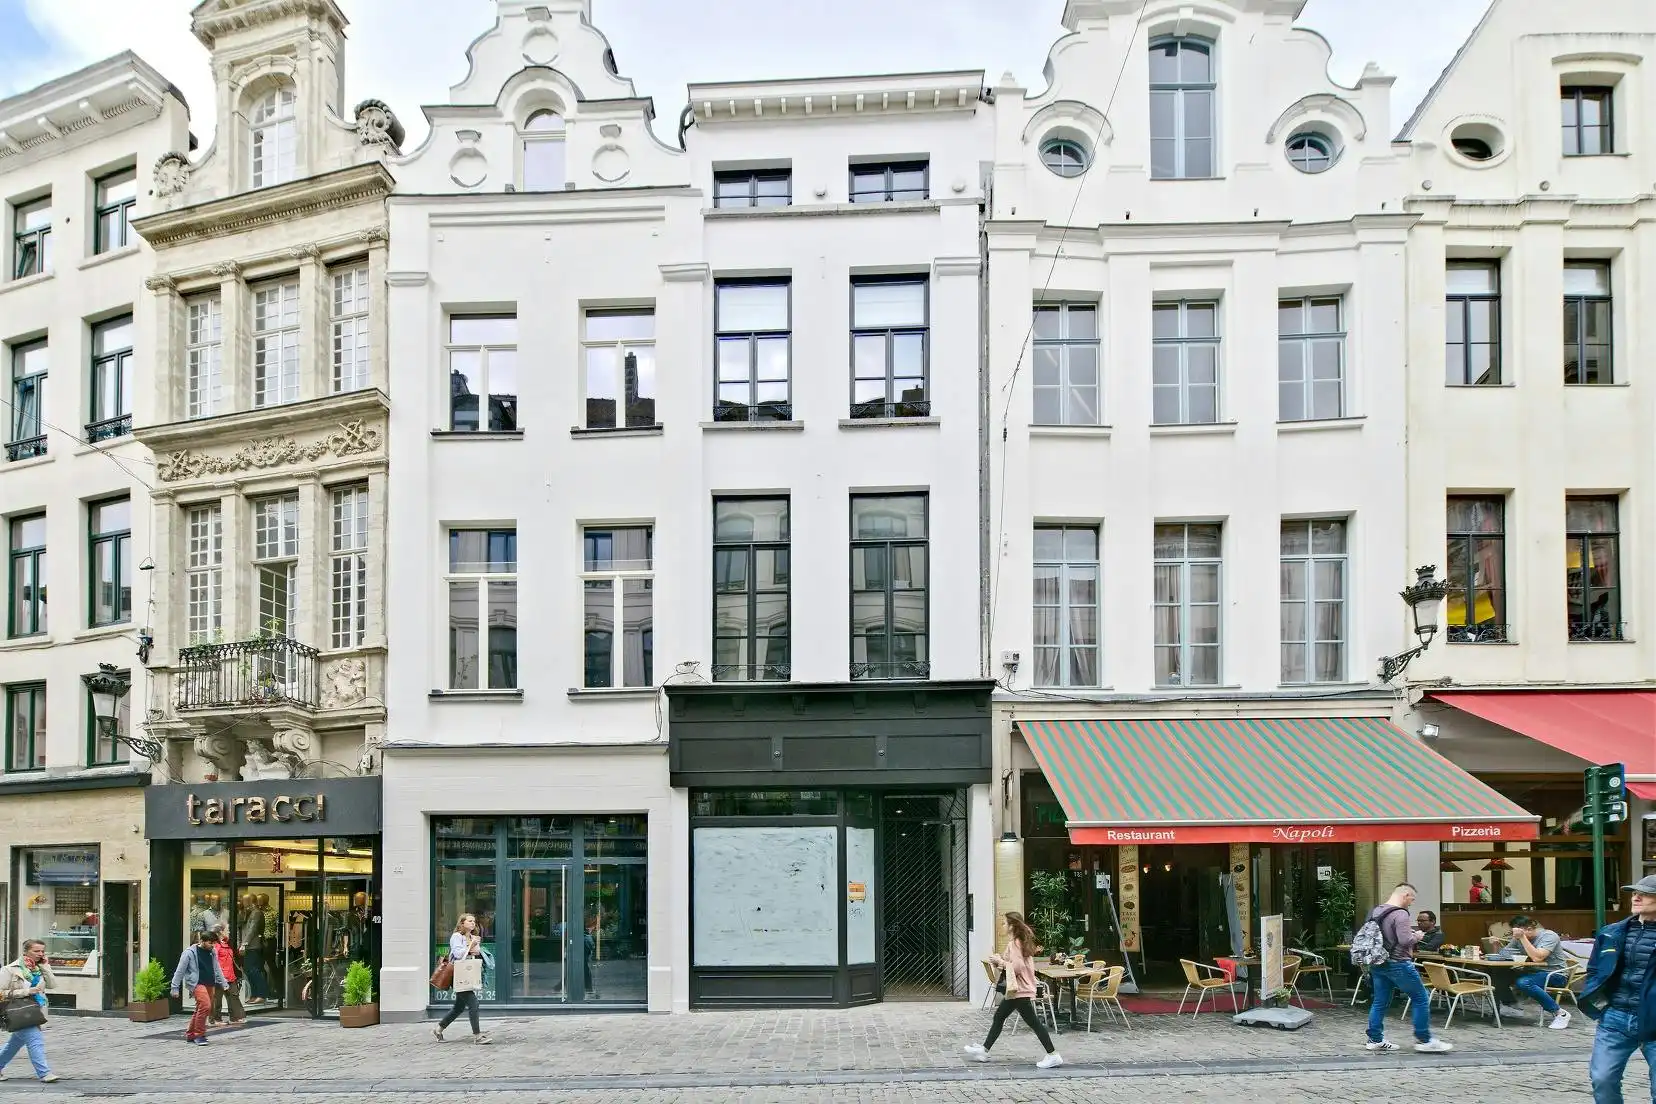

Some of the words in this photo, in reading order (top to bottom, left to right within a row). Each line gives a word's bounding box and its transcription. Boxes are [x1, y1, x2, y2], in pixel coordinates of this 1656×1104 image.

[186, 793, 326, 825] taracci
[1107, 830, 1176, 841] Restaurant
[1272, 825, 1335, 842] Napoli
[1451, 825, 1502, 837] Pizzeria
[371, 915, 382, 924] 42
